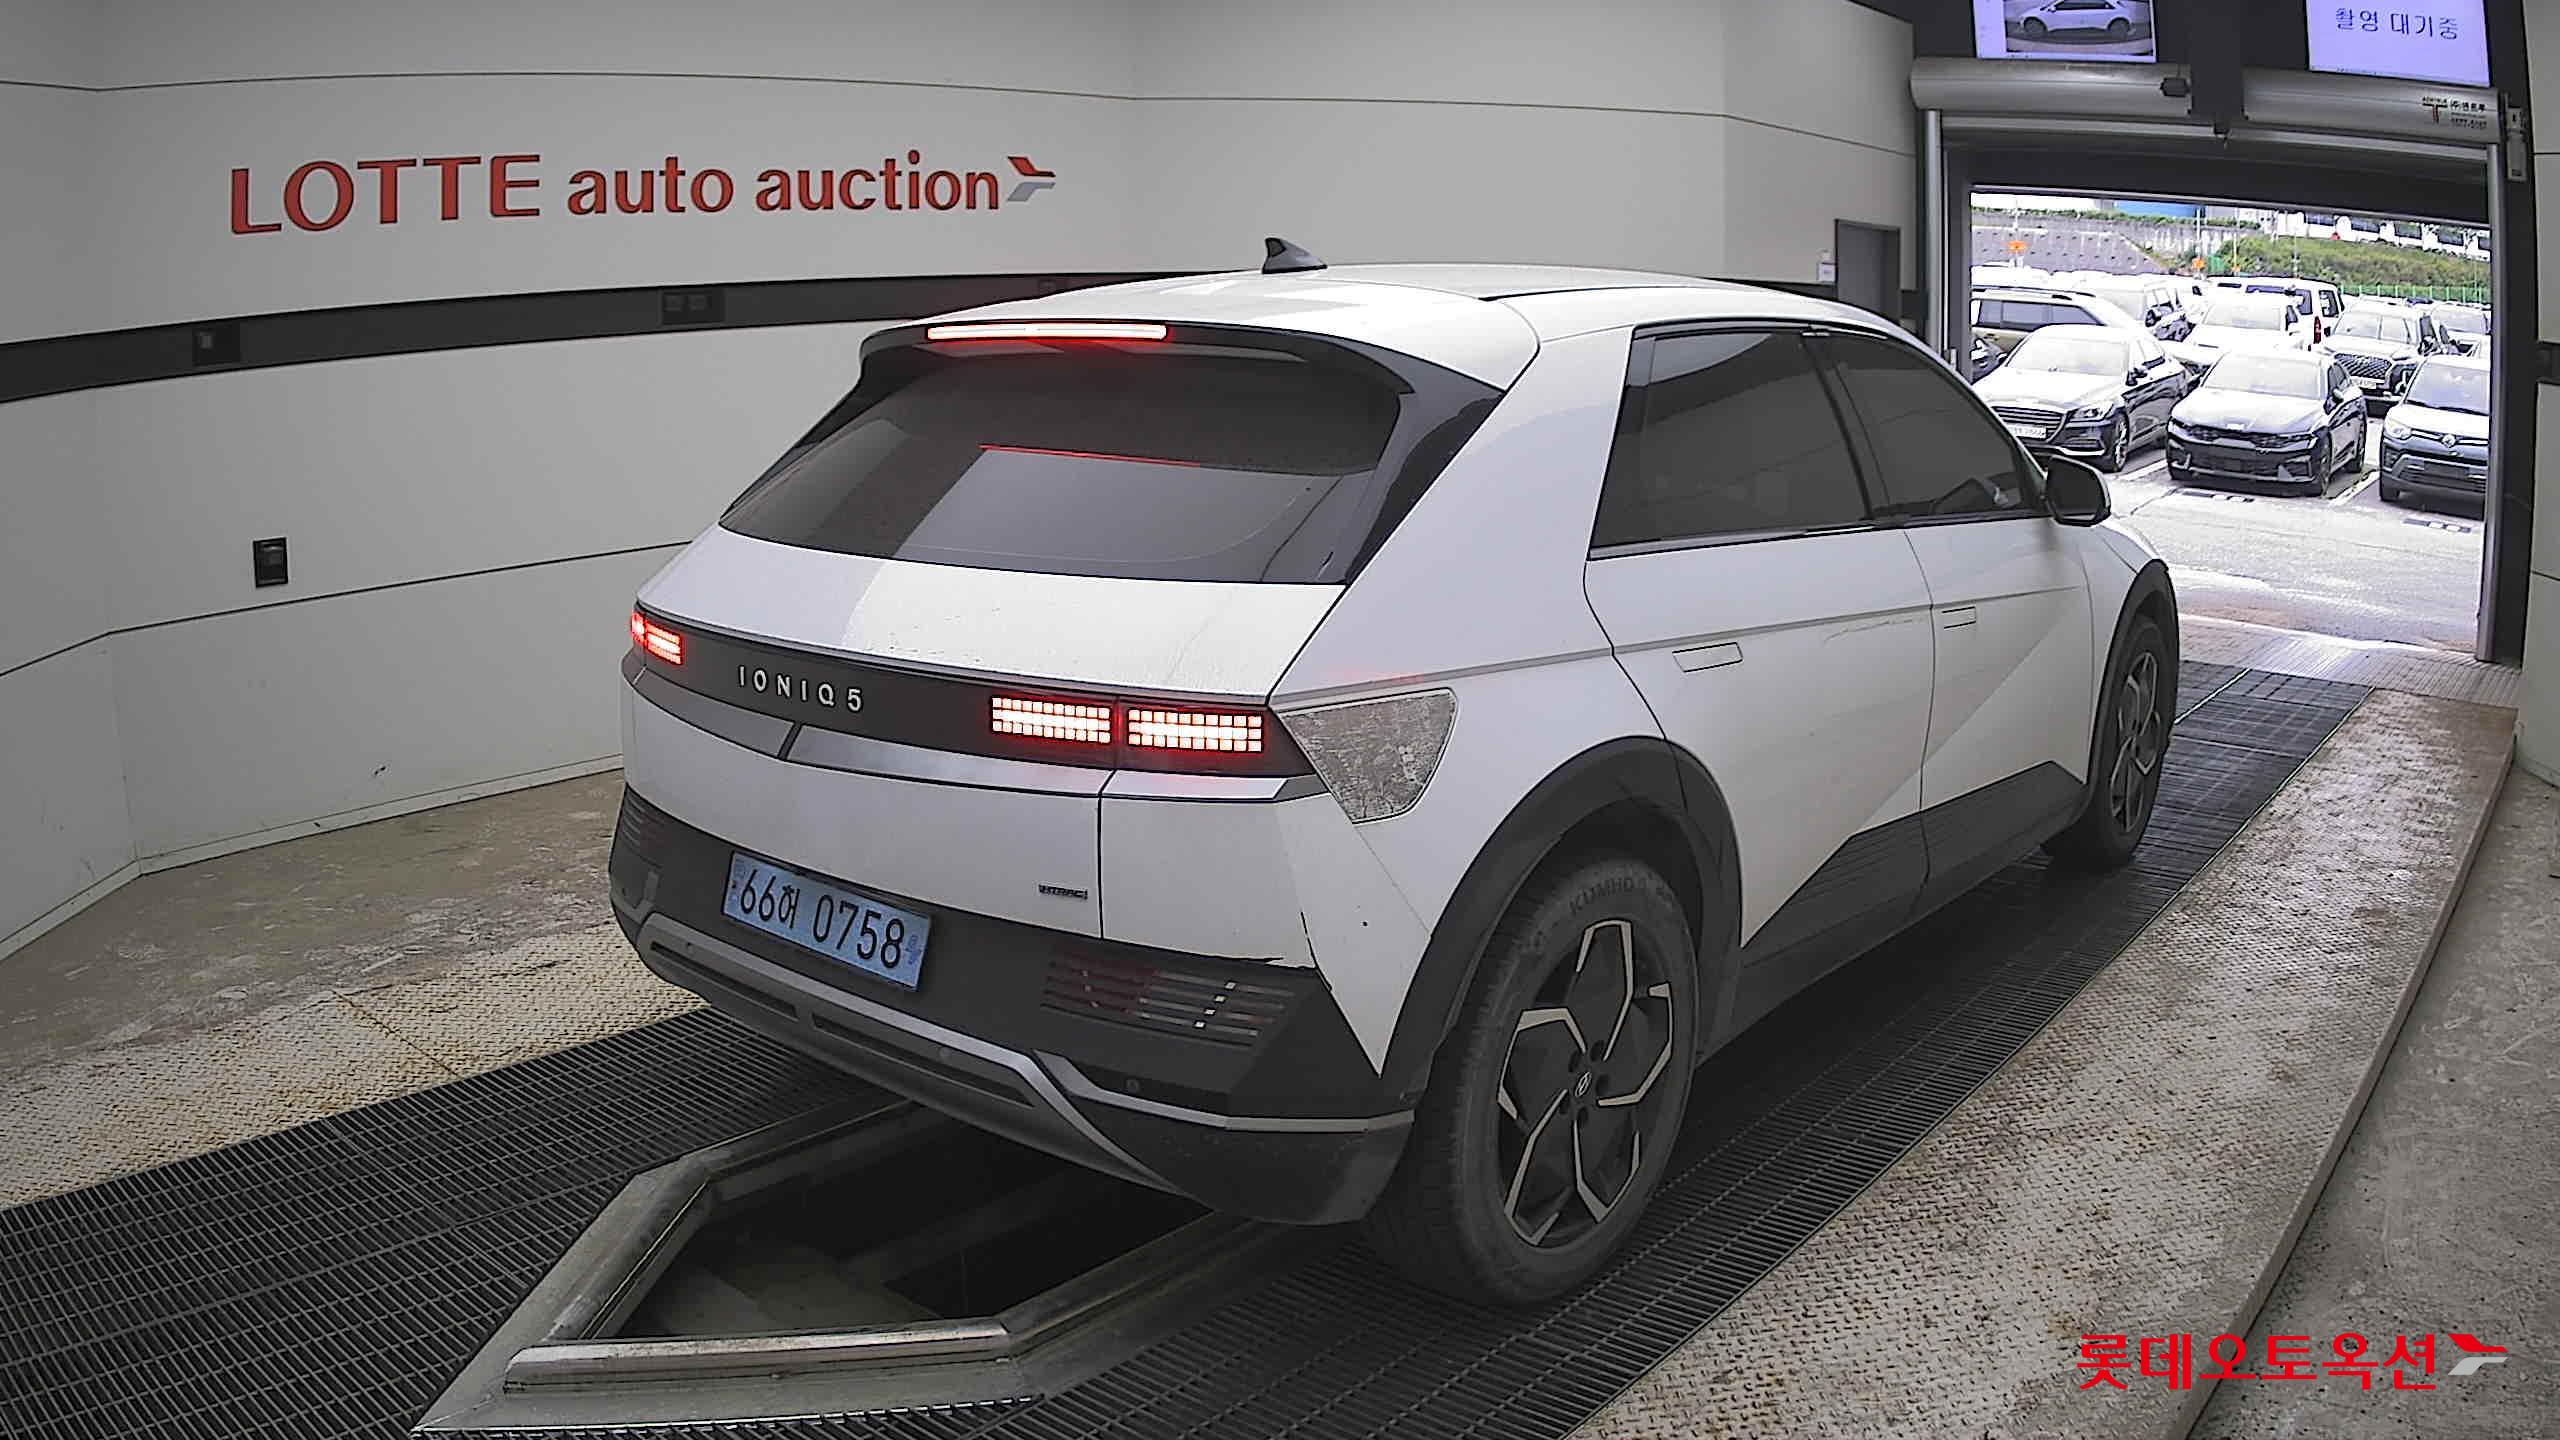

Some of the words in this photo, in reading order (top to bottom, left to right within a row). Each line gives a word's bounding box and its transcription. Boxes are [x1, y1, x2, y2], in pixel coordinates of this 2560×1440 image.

[2336, 8, 2378, 32] 촬영
[2391, 13, 2457, 40] 대기중
[231, 155, 540, 235] LOTTE
[567, 156, 734, 215] auto
[755, 149, 1000, 212] auction
[737, 665, 835, 707] IONIQ
[740, 869, 800, 929] 66허
[812, 894, 905, 969] 0758
